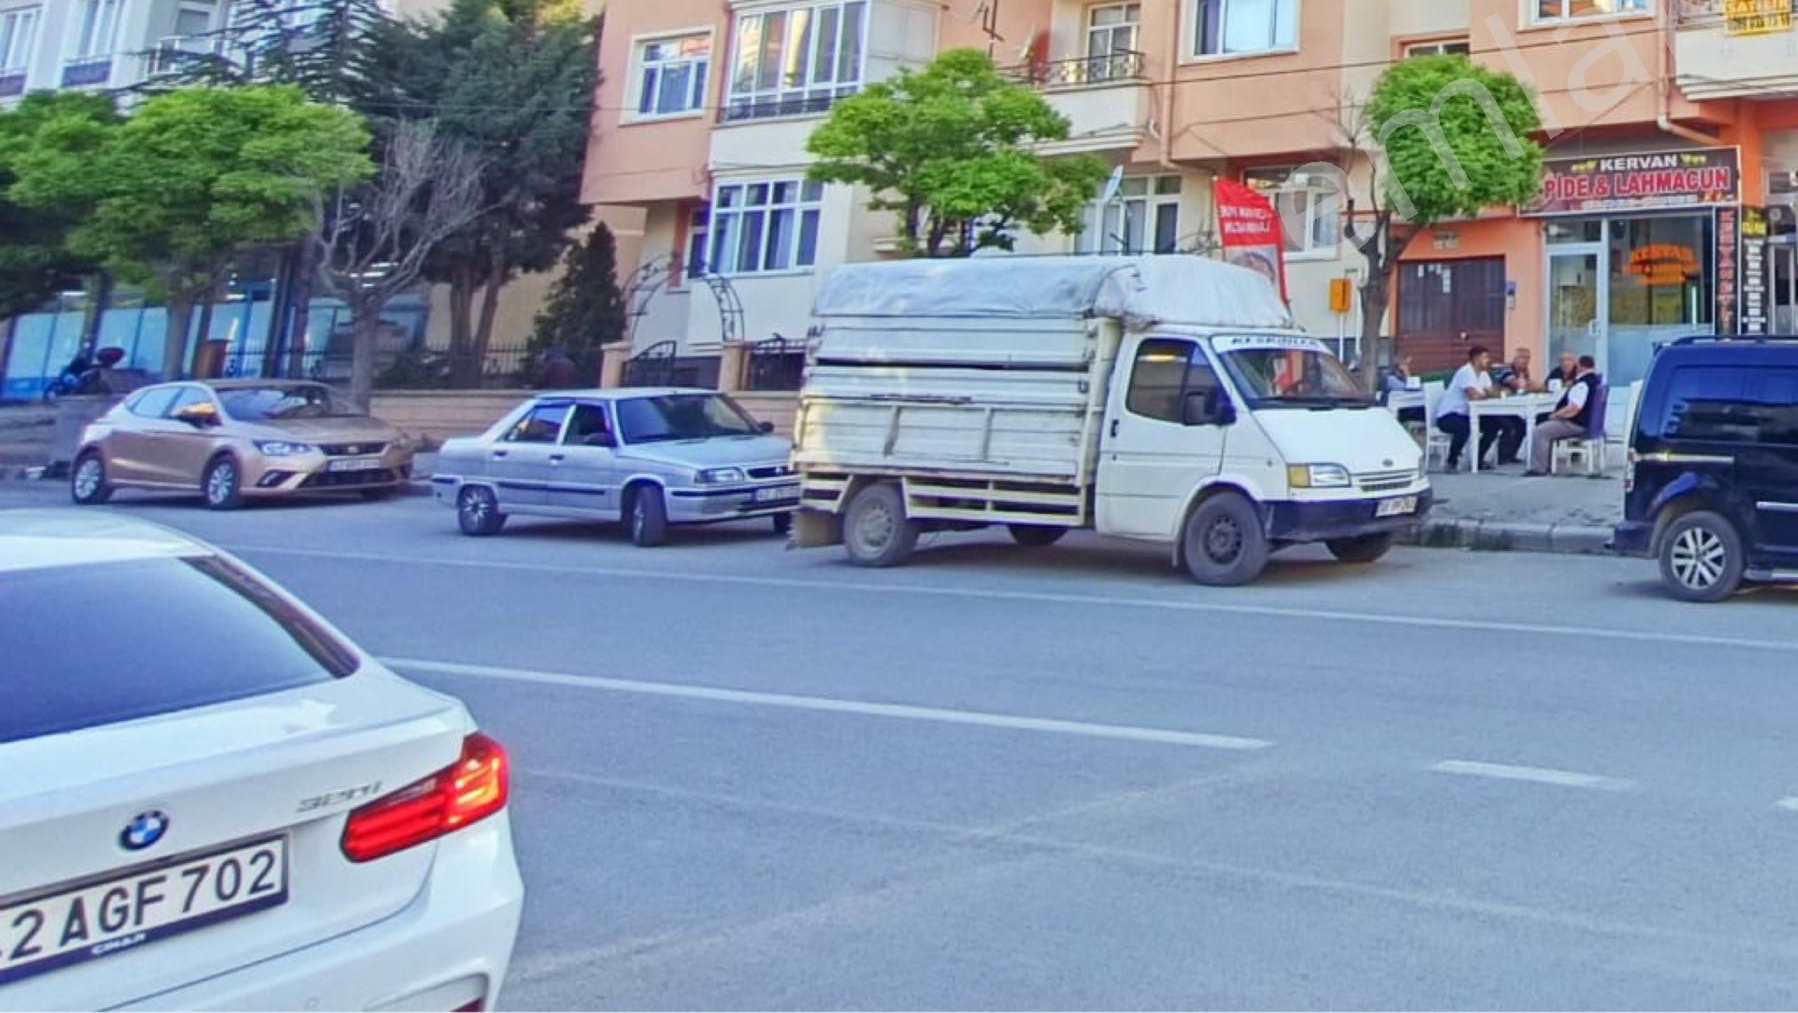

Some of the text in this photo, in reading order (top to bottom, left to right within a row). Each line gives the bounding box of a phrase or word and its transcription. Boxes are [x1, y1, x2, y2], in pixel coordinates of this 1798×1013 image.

[1600, 154, 1678, 172] KERVAN
[1543, 167, 1731, 200] PİDE & LAHMACUN
[0, 849, 276, 961] 2 AGF 702
